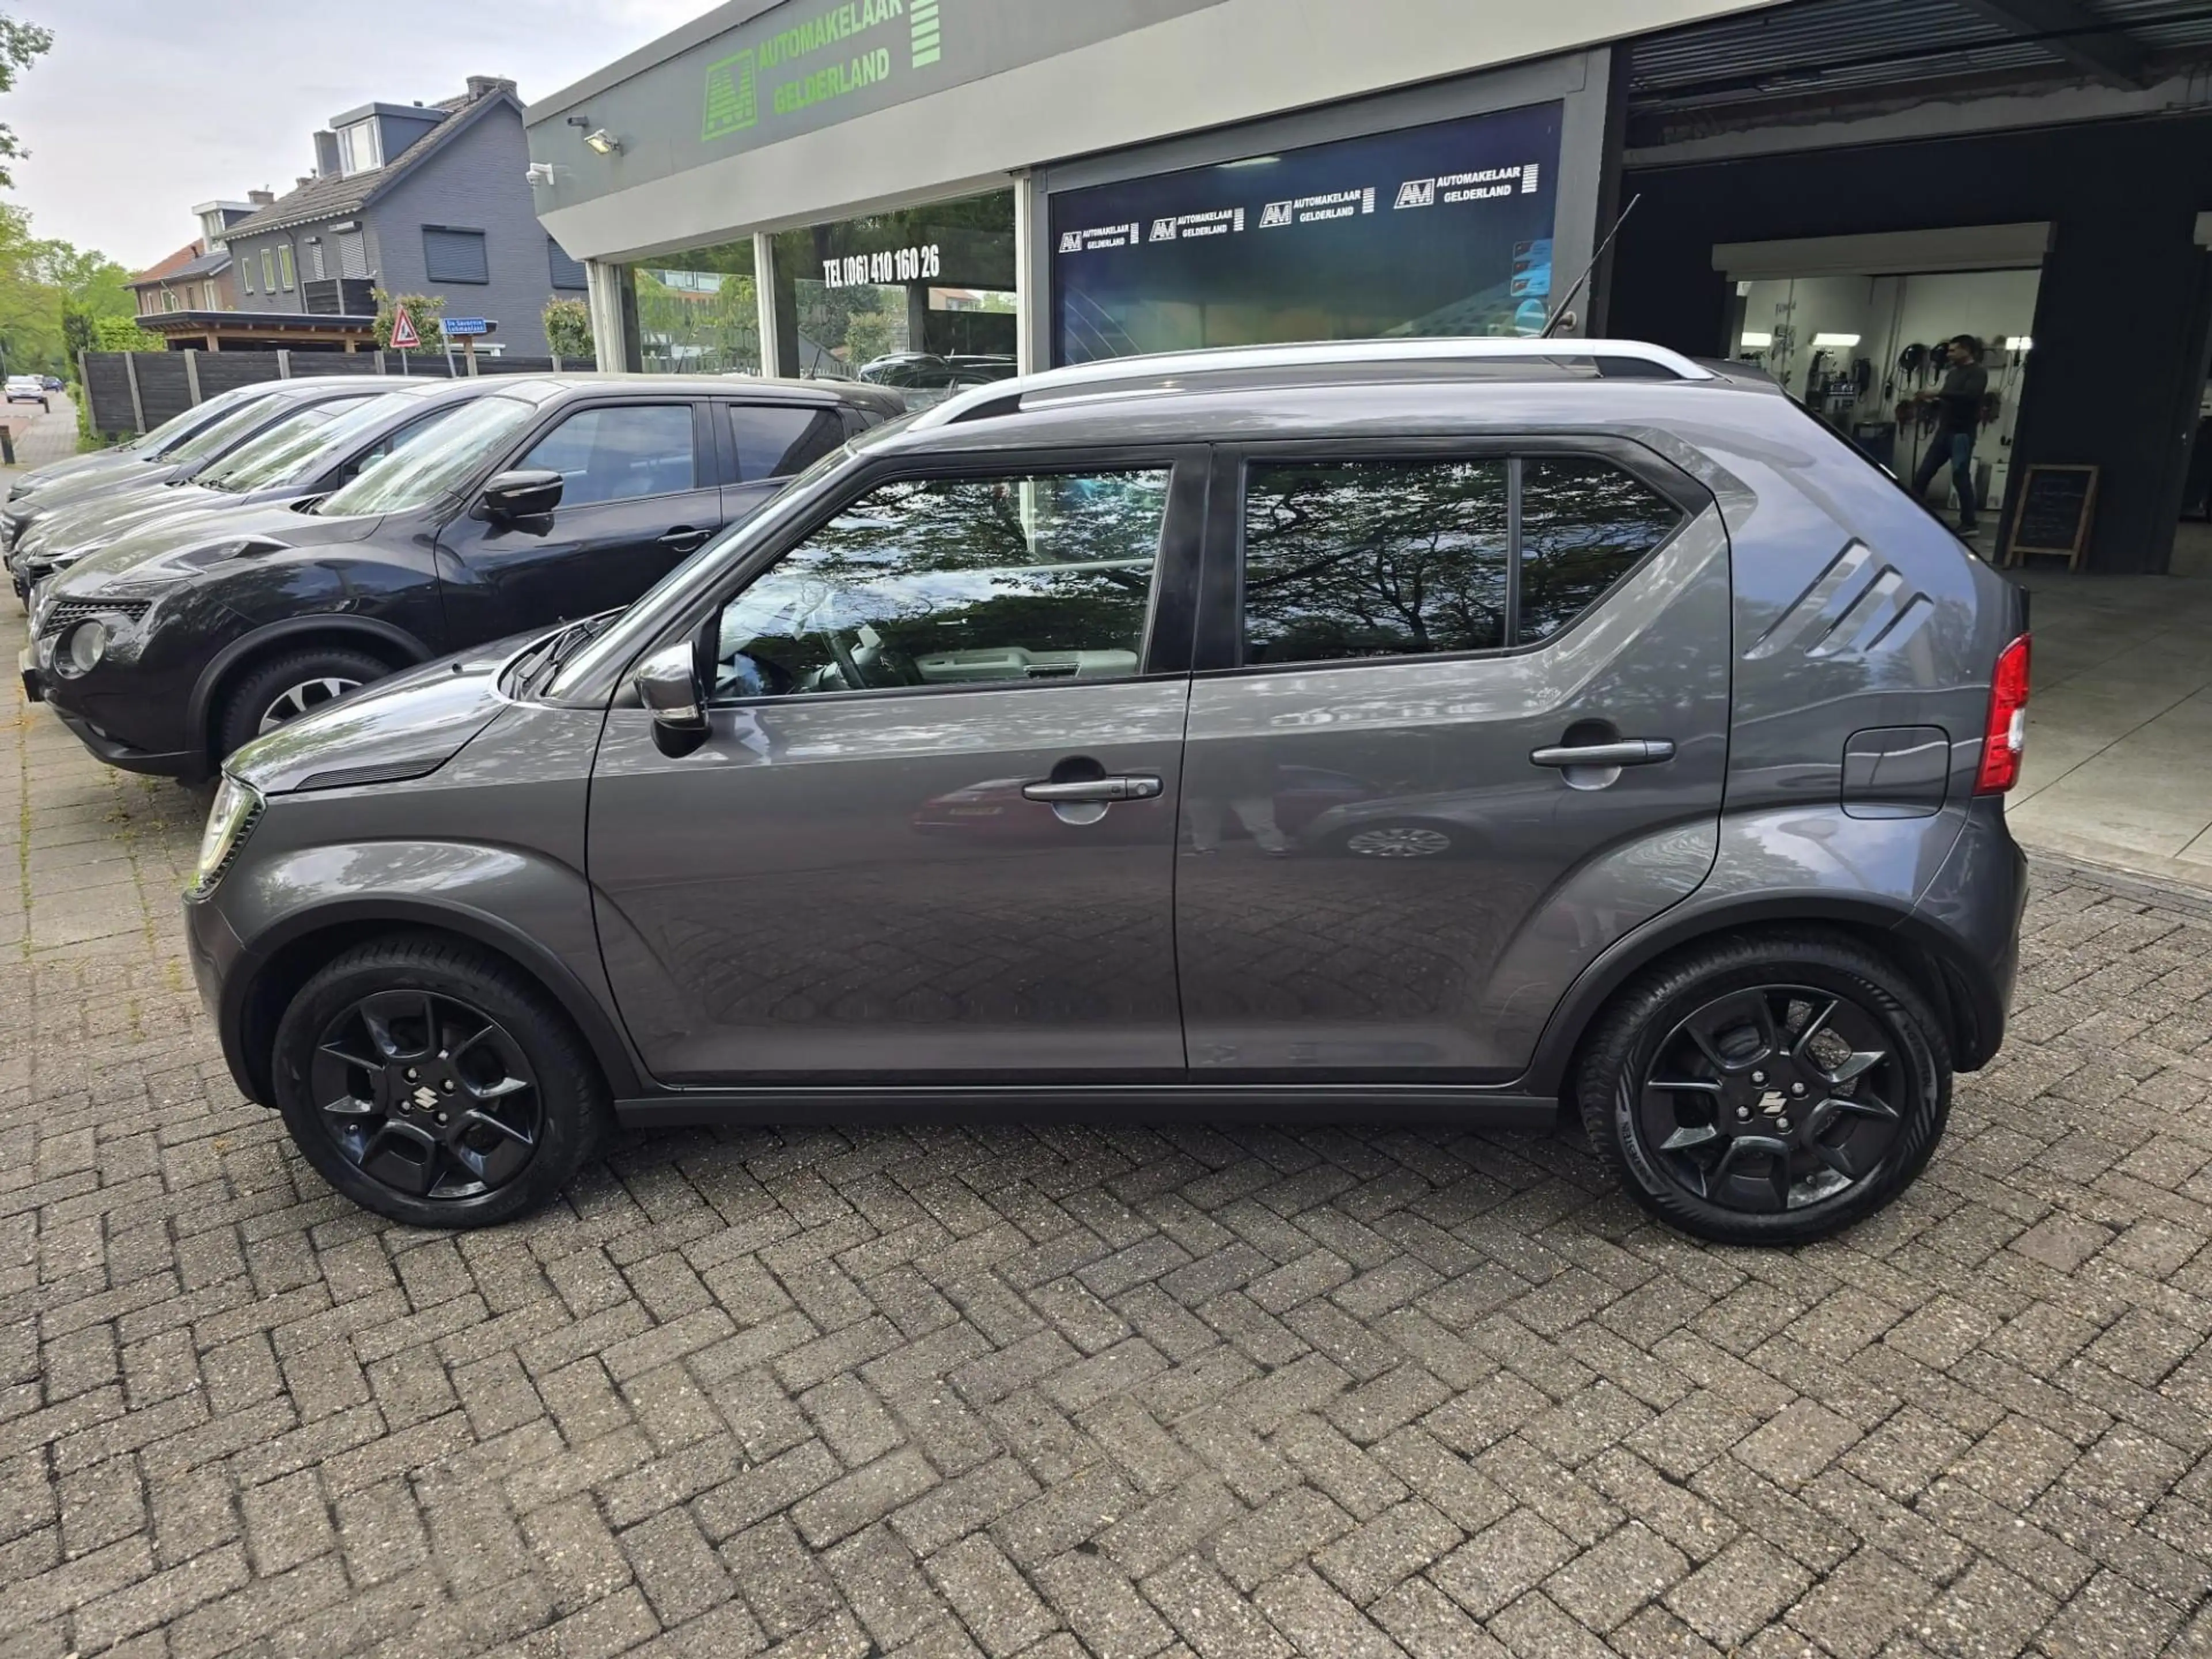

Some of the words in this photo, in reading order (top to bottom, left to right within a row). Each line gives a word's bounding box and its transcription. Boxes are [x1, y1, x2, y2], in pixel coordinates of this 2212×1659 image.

[774, 47, 890, 115] GELDERLAND
[1436, 166, 1521, 188] AUTOMAKELAAR
[1293, 189, 1362, 209] AUTOMAKELAAR
[1444, 184, 1512, 203] GELDERLAND
[1177, 209, 1233, 226] AUTOMAKELAAR
[1300, 206, 1354, 222] GELDERLAND
[1182, 224, 1228, 238] GELDERLAND
[823, 258, 843, 289] TEL
[843, 254, 869, 287] (06)
[870, 251, 893, 283] 410
[894, 246, 919, 281] 160
[921, 244, 940, 278] 26
